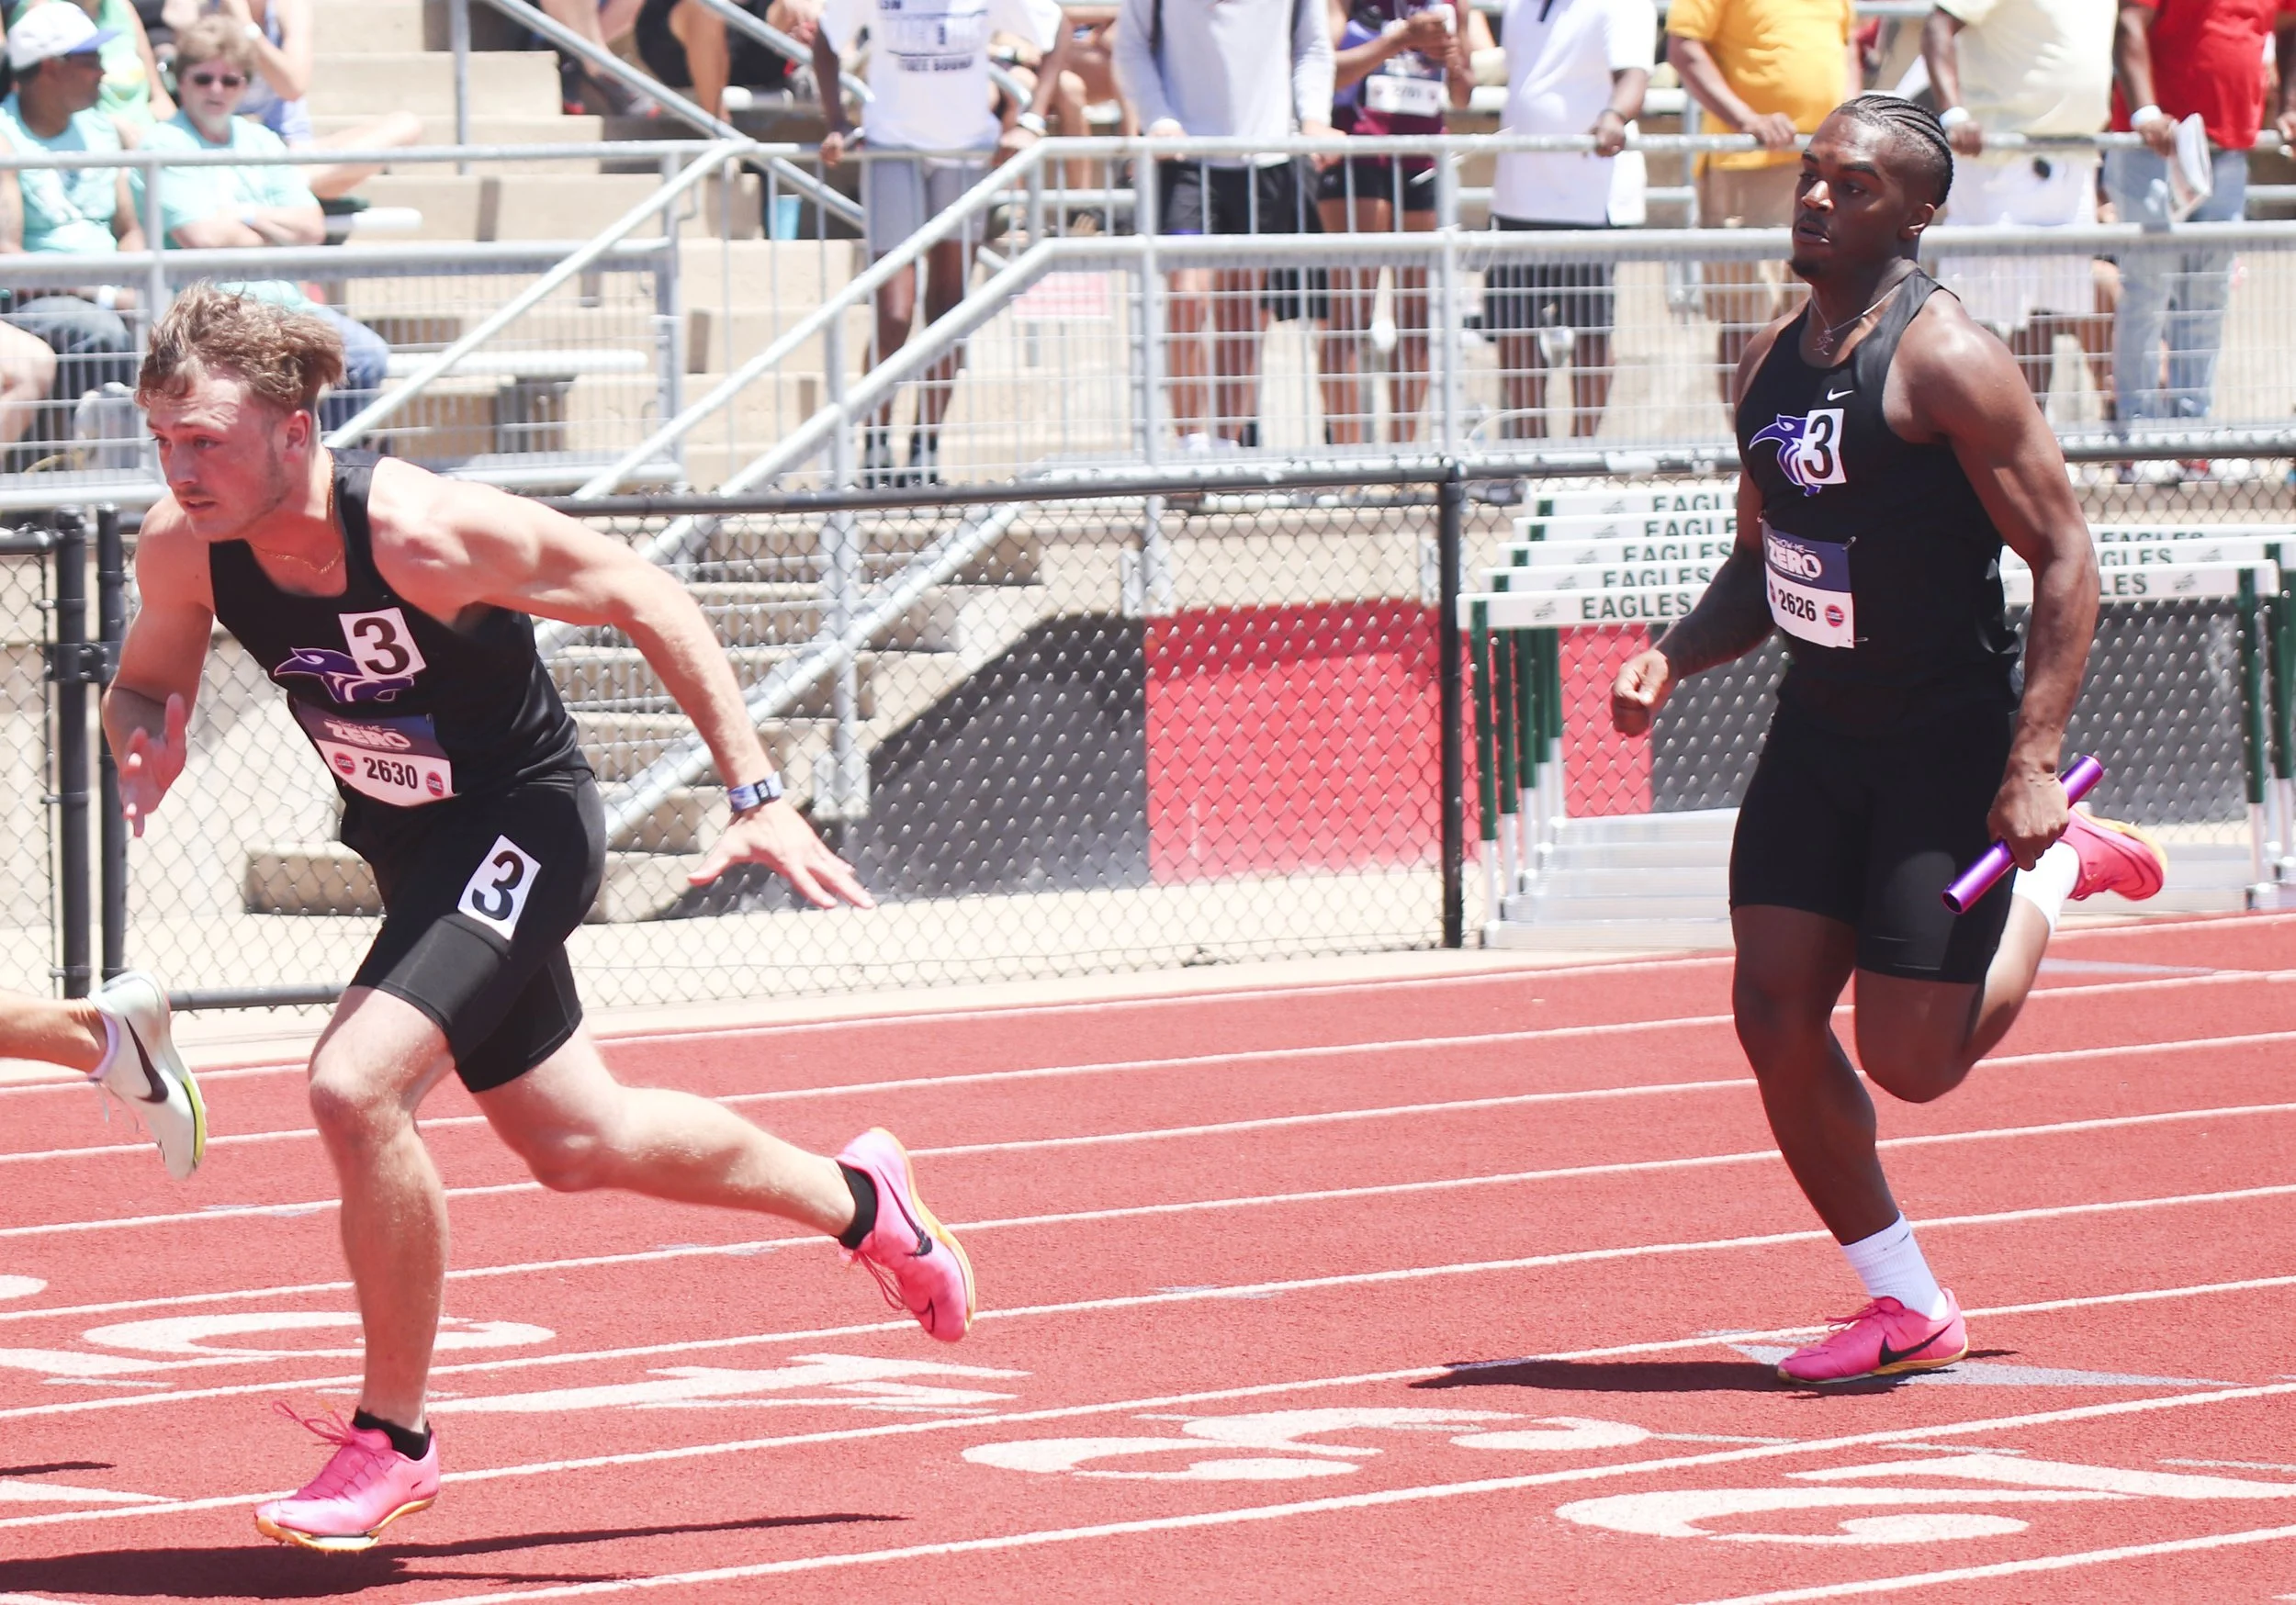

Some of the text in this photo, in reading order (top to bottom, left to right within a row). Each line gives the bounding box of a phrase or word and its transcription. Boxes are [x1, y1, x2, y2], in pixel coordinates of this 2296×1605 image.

[1803, 414, 1834, 479] 3
[1623, 542, 1733, 562] EAGLES
[1766, 538, 1823, 578] ZERO
[1603, 567, 1712, 588] EAGLES
[1581, 592, 1693, 620] EAGLES
[1777, 589, 1817, 622] 2626
[353, 616, 411, 675] 3
[323, 721, 411, 748] ZERO
[363, 757, 419, 790] 2630
[471, 850, 524, 921] 3
[959, 1407, 1653, 1480] 3
